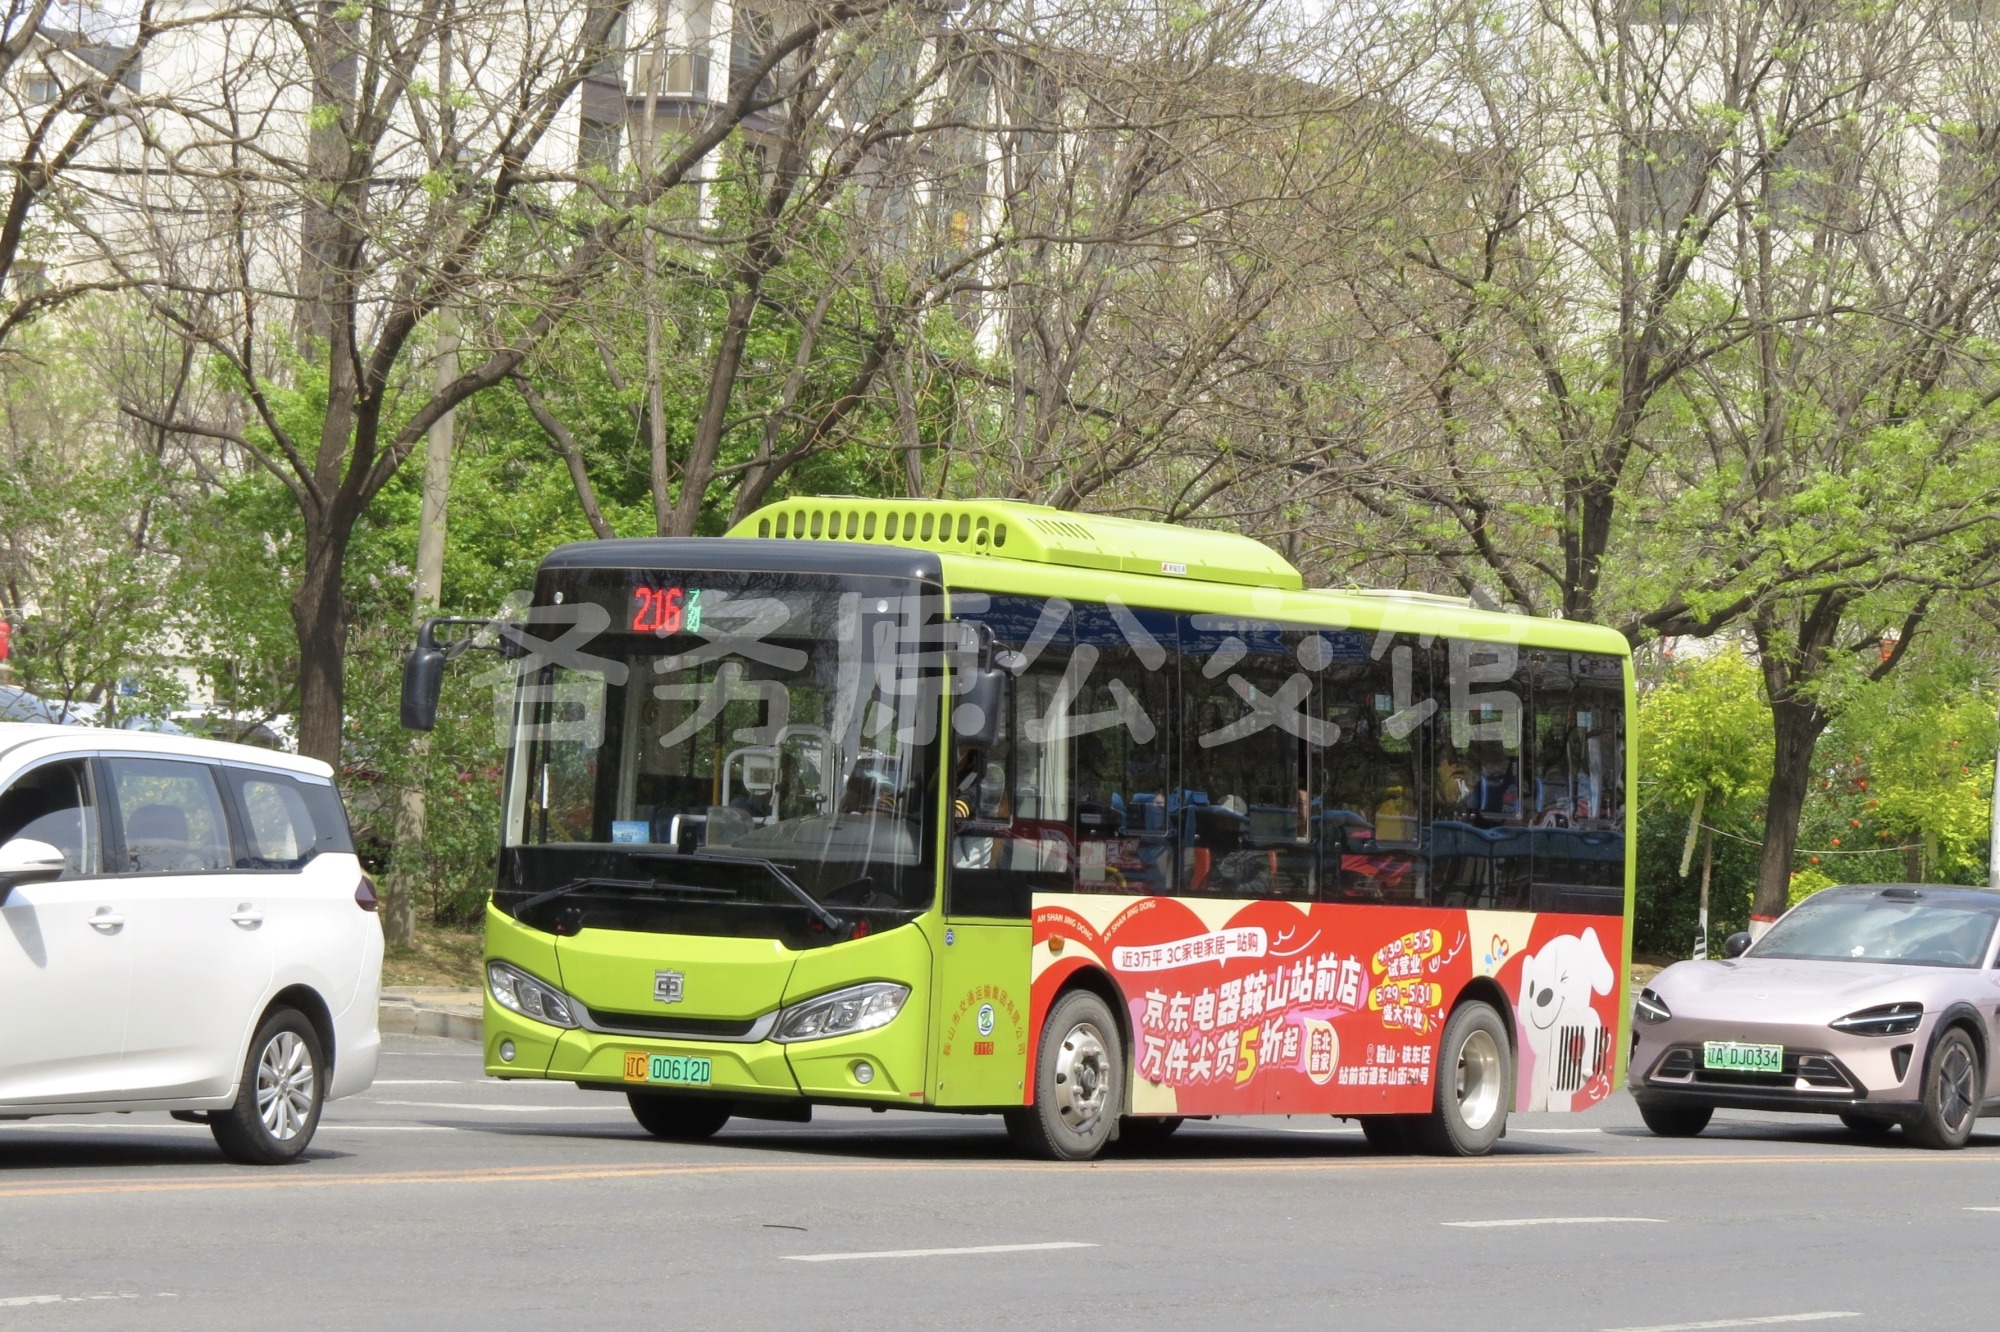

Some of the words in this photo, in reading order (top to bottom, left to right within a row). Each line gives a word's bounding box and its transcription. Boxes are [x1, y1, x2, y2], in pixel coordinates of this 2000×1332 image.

[633, 587, 682, 632] 216
[1037, 914, 1046, 924] AN
[1046, 913, 1064, 923] SHAN
[1076, 922, 1093, 941] DONG
[1103, 931, 1111, 944] AN
[1111, 915, 1127, 932] SHAN
[1139, 900, 1156, 911] DONG
[1122, 949, 1163, 968] 近3万平
[1166, 932, 1259, 964] 3C家电家居一站购
[1387, 953, 1421, 977] 试营业
[1141, 951, 1362, 1033] 京东电器鞍山站前店
[943, 984, 1026, 1057] 鞍山市交通运输集团有限公司
[1382, 1003, 1424, 1030] 盛大开业
[1140, 1015, 1300, 1085] 万件尖货5折起
[1312, 1032, 1331, 1051] 东北
[626, 1056, 646, 1078] 辽C
[652, 1058, 710, 1082] 00612D
[1311, 1053, 1330, 1072] 首家
[1730, 1048, 1779, 1067] DJ0334
